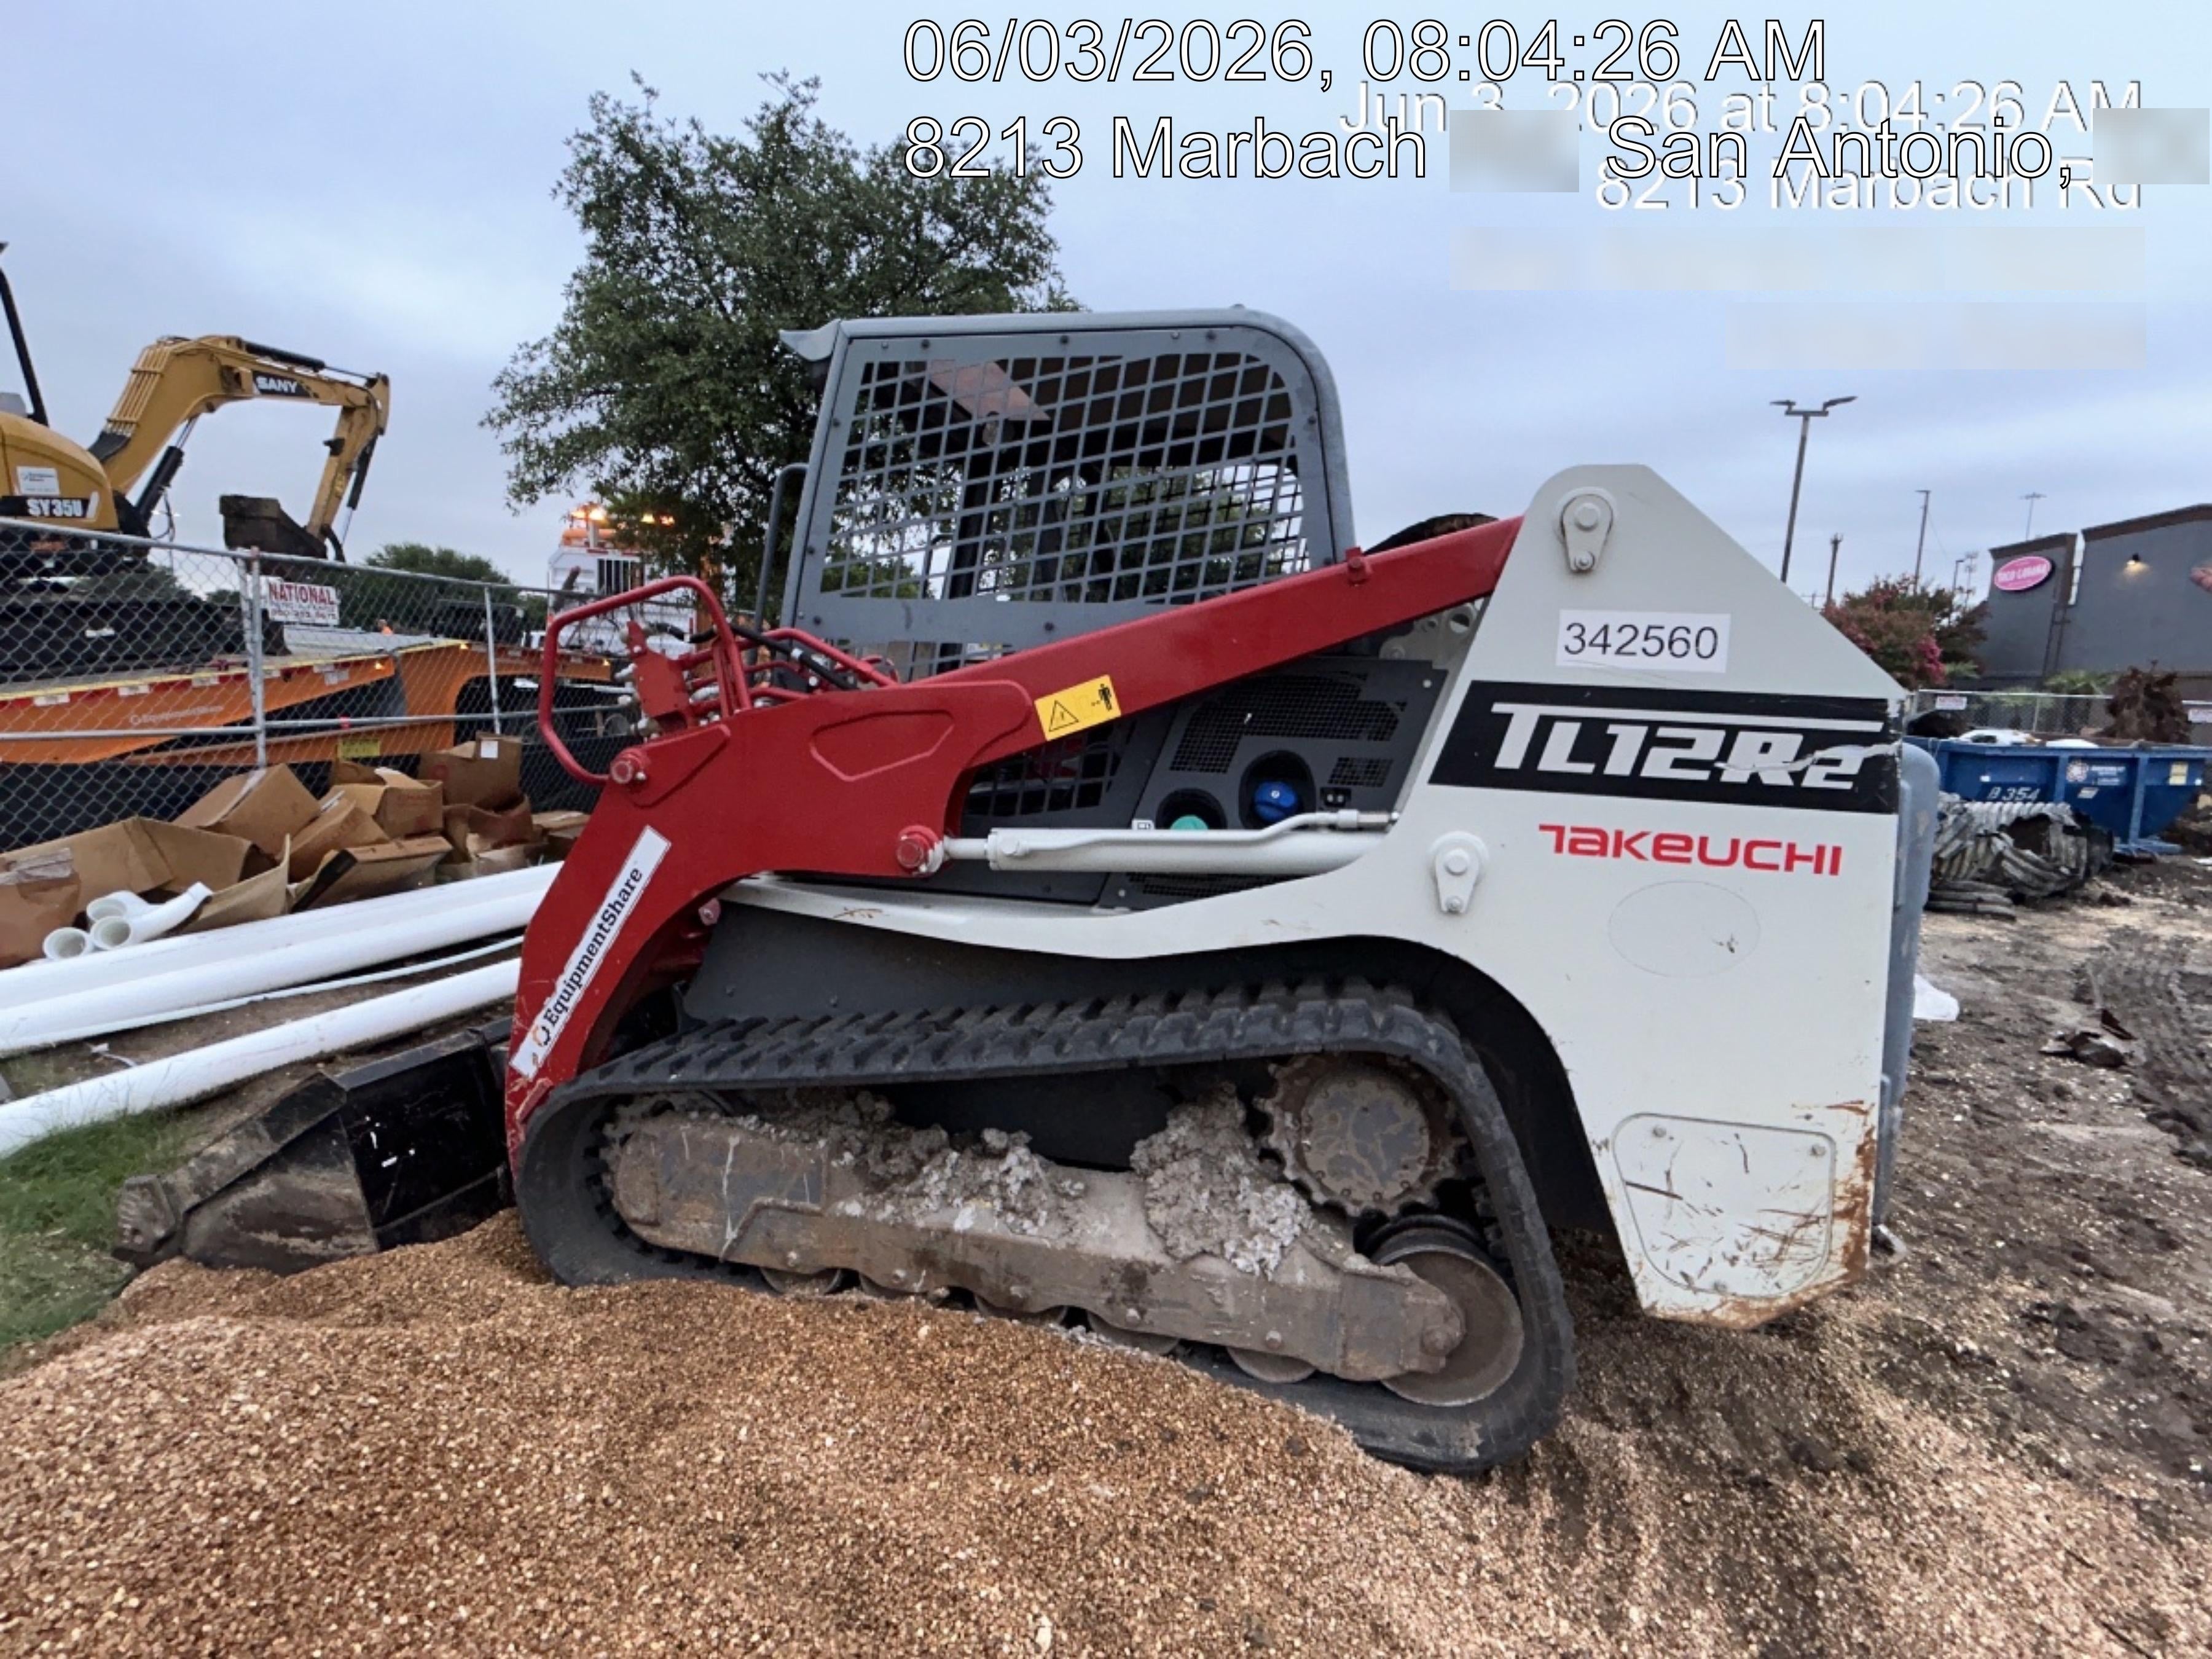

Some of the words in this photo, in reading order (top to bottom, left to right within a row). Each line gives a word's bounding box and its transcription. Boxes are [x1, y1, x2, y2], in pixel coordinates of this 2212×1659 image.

[256, 375, 297, 393] SANY
[269, 582, 335, 606] NATIONAL
[1564, 621, 1719, 660] 342560
[1491, 702, 1884, 790] TL12R2
[543, 868, 643, 1027] EquipmentShare
